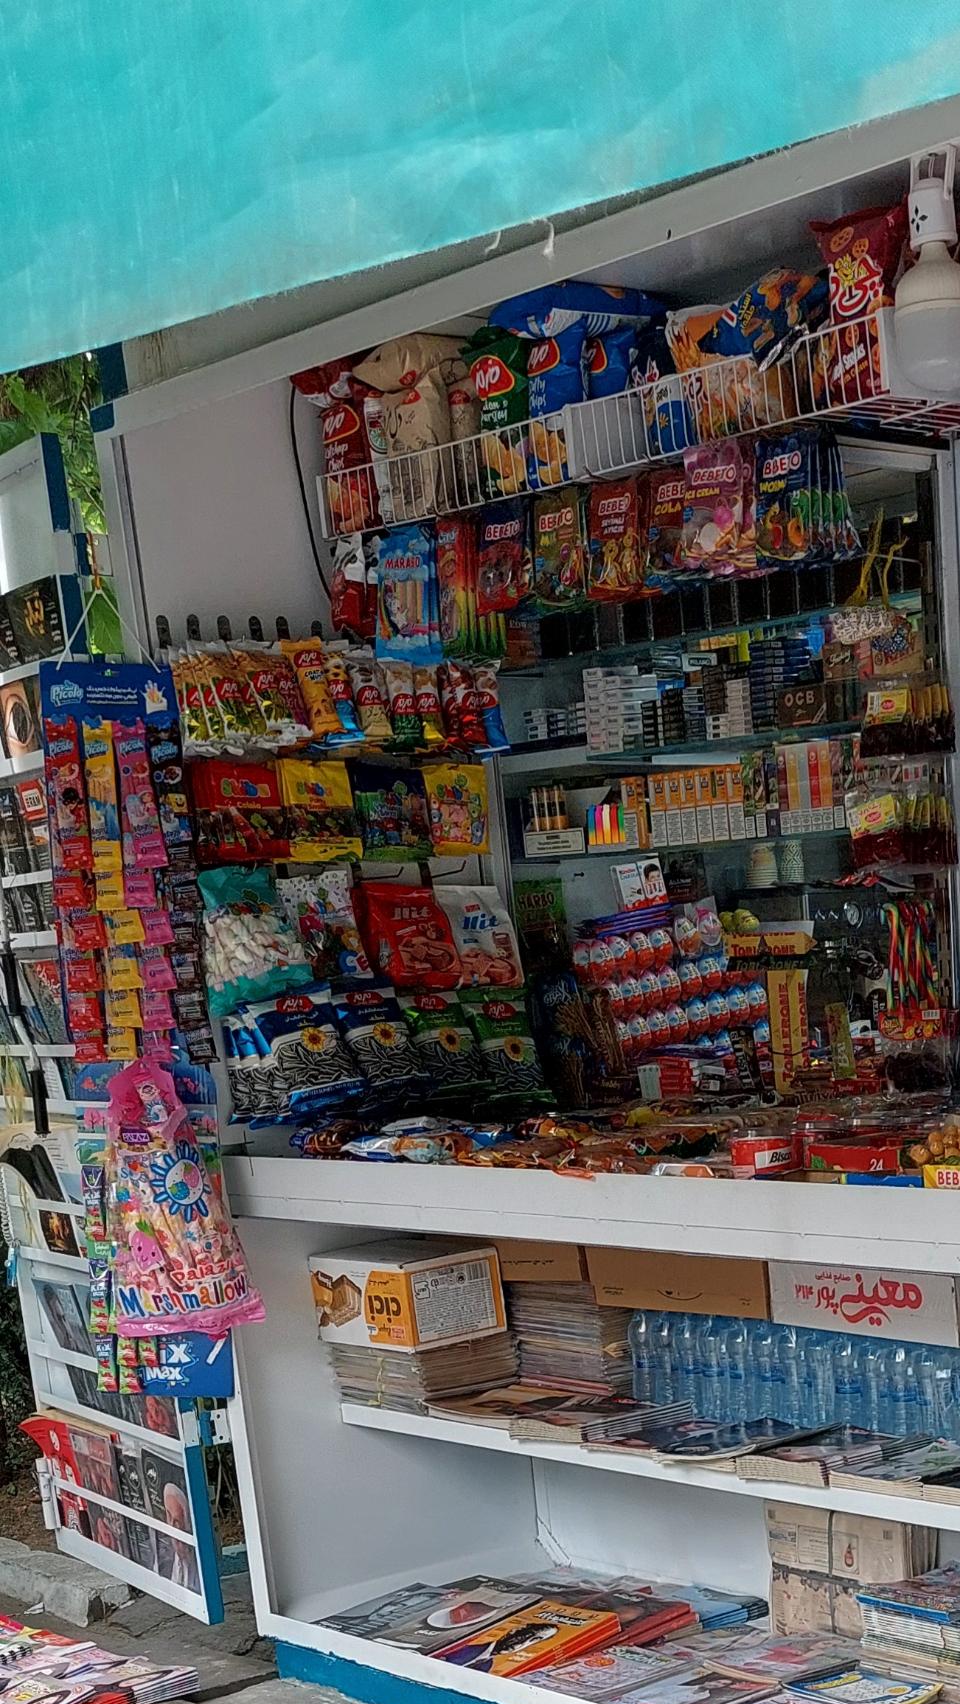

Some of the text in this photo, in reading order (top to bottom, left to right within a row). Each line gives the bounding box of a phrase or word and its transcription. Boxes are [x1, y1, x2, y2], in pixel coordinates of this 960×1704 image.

[692, 464, 737, 485] BEBETO
[657, 481, 685, 502] BEBE
[654, 502, 682, 516] COLA
[784, 691, 815, 706] OCB
[870, 1158, 884, 1172] 24
[117, 1275, 248, 1318] Marshmallow
